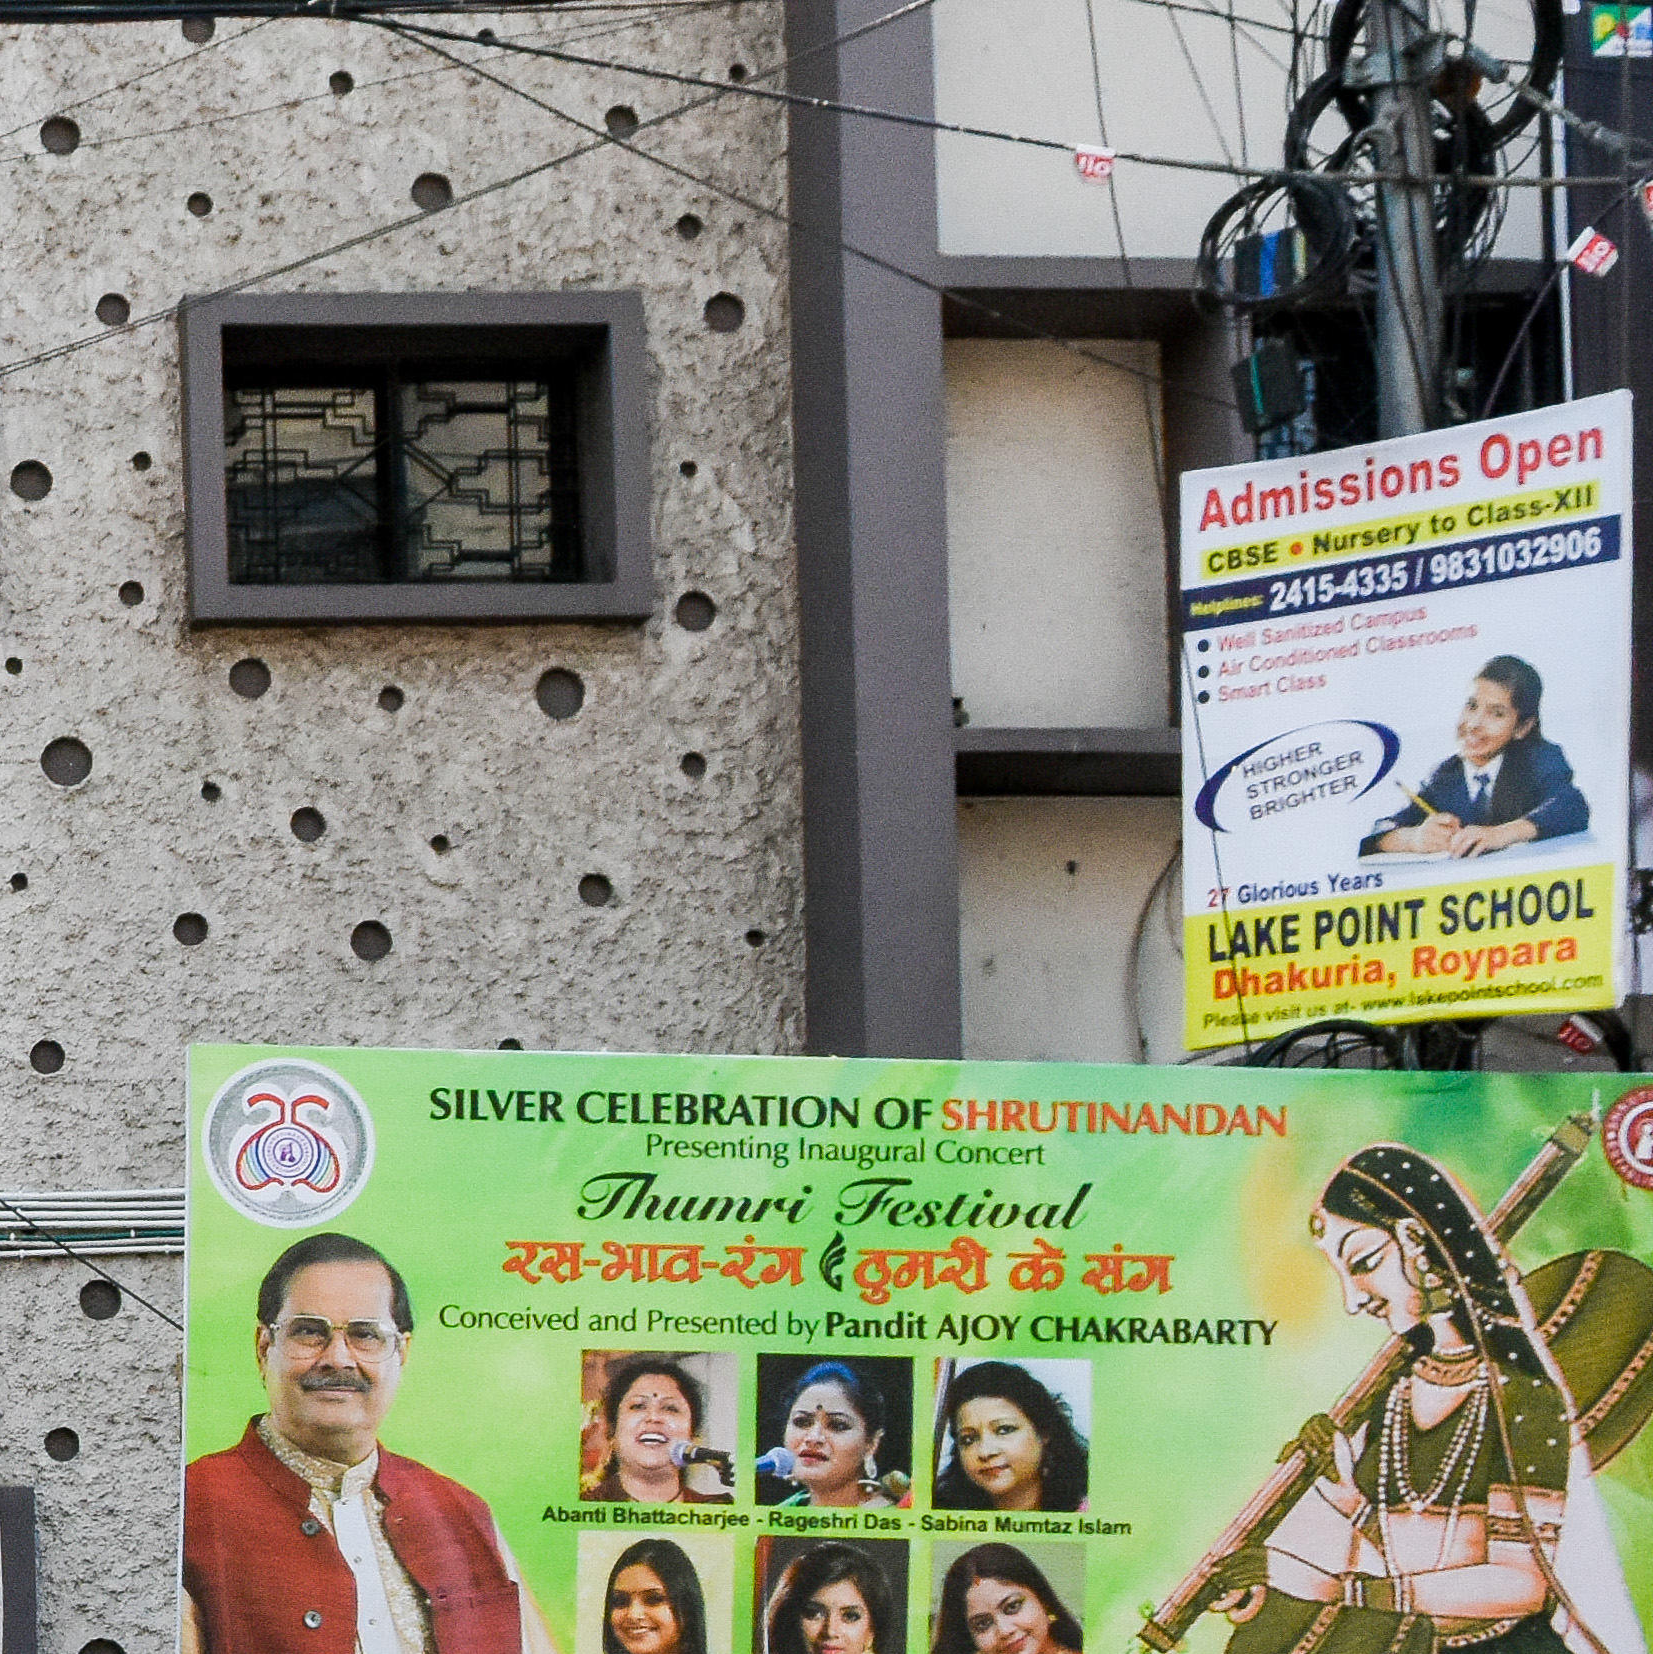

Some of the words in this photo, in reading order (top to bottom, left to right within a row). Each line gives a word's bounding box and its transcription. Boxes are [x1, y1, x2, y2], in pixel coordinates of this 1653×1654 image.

[1200, 453, 1460, 531] Admissions
[1480, 426, 1604, 486] Open
[1207, 541, 1278, 574] CBSE
[1313, 519, 1419, 555] Nursery
[1430, 513, 1455, 534] to
[1468, 484, 1593, 528] Class-XII
[1269, 560, 1408, 612] 2415-4335
[1430, 527, 1601, 583] 9831032906
[1243, 742, 1322, 778] HIGHER
[1247, 751, 1363, 800] STRONGER
[1251, 776, 1358, 820] BRIGHTER
[1238, 878, 1318, 904] Glorious
[1327, 872, 1383, 894] Years
[1208, 914, 1299, 962] LAKE
[1315, 899, 1424, 948] POINT
[1440, 878, 1594, 935] SCHOOL
[1213, 955, 1397, 1001] Dhakuria,
[1411, 936, 1578, 985] Roypara
[430, 1088, 565, 1123] SILVER
[576, 1091, 859, 1129] CELEBRATION
[874, 1098, 932, 1131] OF
[940, 1098, 1295, 1141] SHRUTINANDAN
[646, 1133, 790, 1168] Presenting
[799, 1137, 925, 1171] Inaugural
[934, 1139, 1044, 1165] Concert
[577, 1172, 813, 1225] Thumri
[834, 1177, 1092, 1229] Festival
[501, 1234, 809, 1289] रस-भाव-रंग
[853, 1236, 992, 1305] ठुमरी
[1007, 1238, 1067, 1293] के
[1080, 1246, 1175, 1296] संग
[439, 1304, 579, 1331] Conceived
[588, 1307, 637, 1332] and
[648, 1309, 777, 1336] Presented
[787, 1310, 821, 1344] by
[826, 1310, 928, 1340] Pandit
[936, 1314, 1022, 1346] AJOY
[1027, 1314, 1279, 1345] CHAKRABARTY
[542, 1505, 606, 1524] Abanti
[609, 1506, 749, 1531] Bhattacharjee
[769, 1512, 861, 1535] Rageshri
[864, 1513, 902, 1531] Das
[921, 1514, 988, 1532] Sabina
[995, 1516, 1073, 1534] Mumtaz
[1078, 1518, 1132, 1535] Islam
